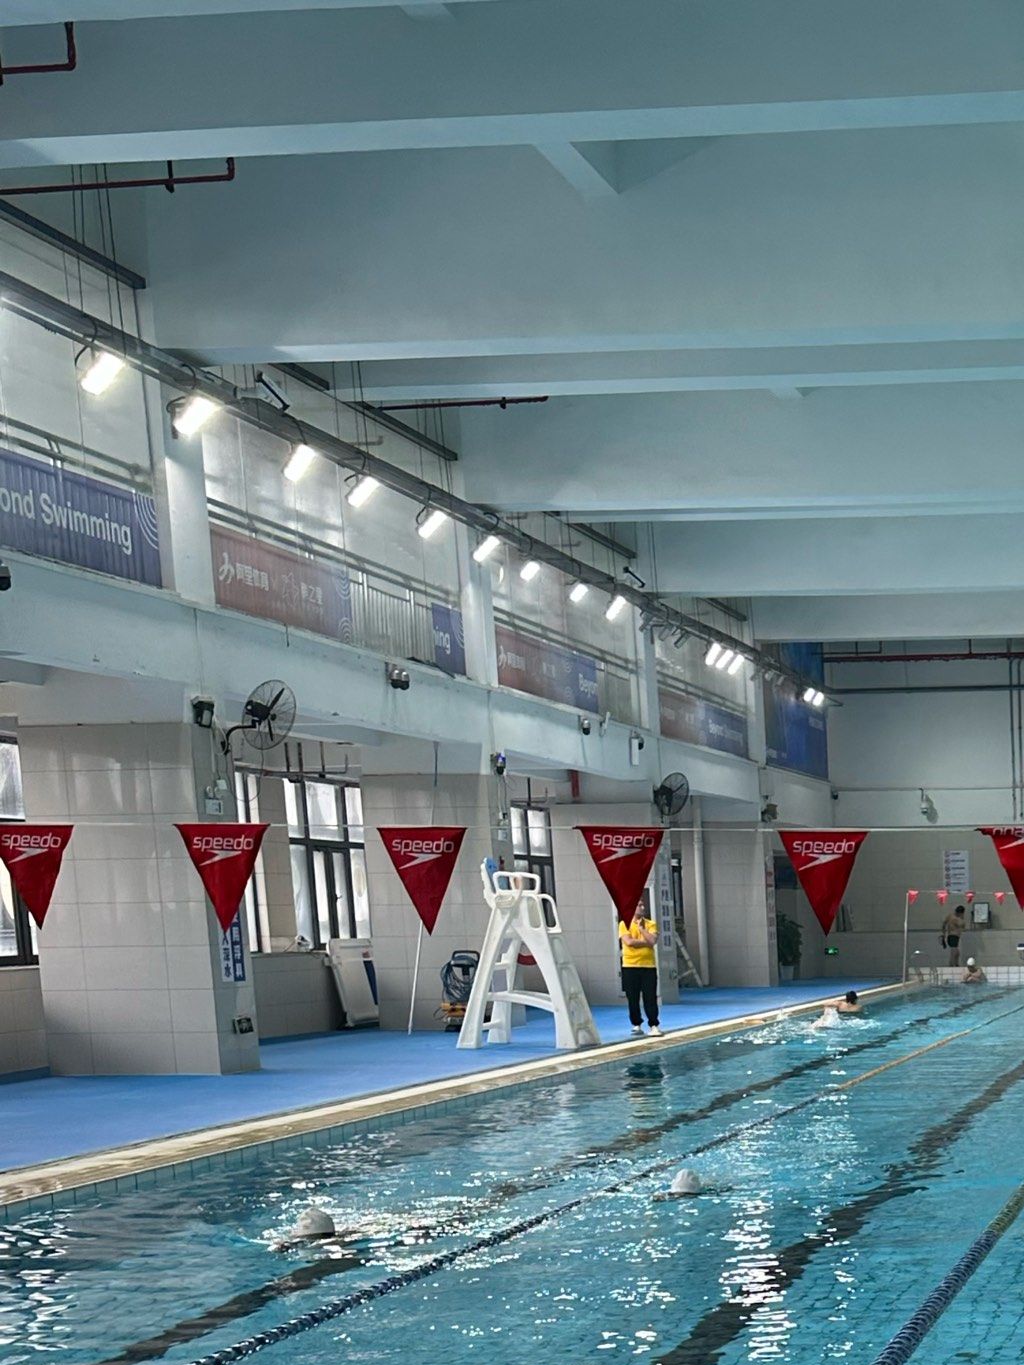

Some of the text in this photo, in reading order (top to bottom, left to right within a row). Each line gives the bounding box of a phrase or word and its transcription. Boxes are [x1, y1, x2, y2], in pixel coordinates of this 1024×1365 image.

[39, 493, 132, 555] Swimming
[0, 832, 62, 850] speedo
[193, 834, 254, 852] speedo
[392, 837, 455, 855] speedo
[592, 833, 655, 850] speedo
[793, 838, 855, 856] speedo
